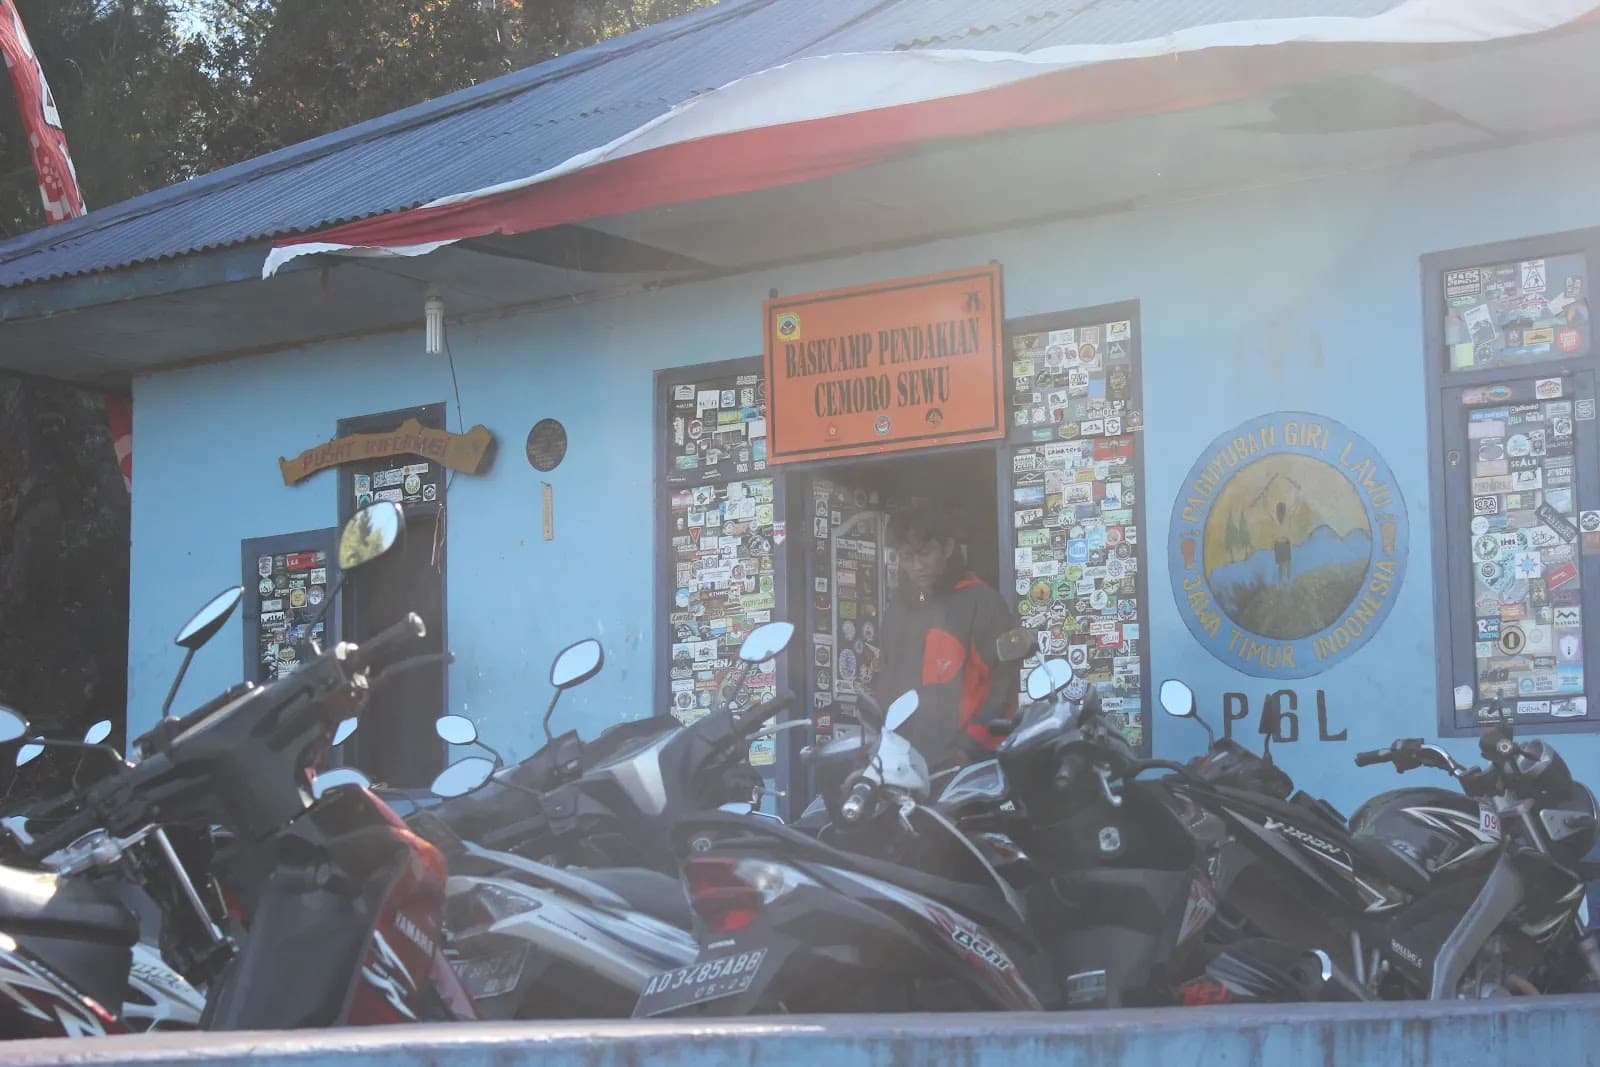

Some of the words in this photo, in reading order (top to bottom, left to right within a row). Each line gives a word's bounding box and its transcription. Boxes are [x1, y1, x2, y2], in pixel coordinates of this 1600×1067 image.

[785, 332, 873, 379] BASECAMP
[878, 317, 979, 366] PENDAKIAN
[814, 374, 891, 418] CEMORO
[897, 366, 950, 408] SEWU
[1181, 426, 1276, 523] PAGUYUBAN
[1284, 421, 1330, 451] GIRI
[1339, 442, 1393, 509] LAWU
[1183, 577, 1222, 639] JAWA
[1227, 629, 1297, 670] TIMUR
[1312, 558, 1396, 663] INDONESIA
